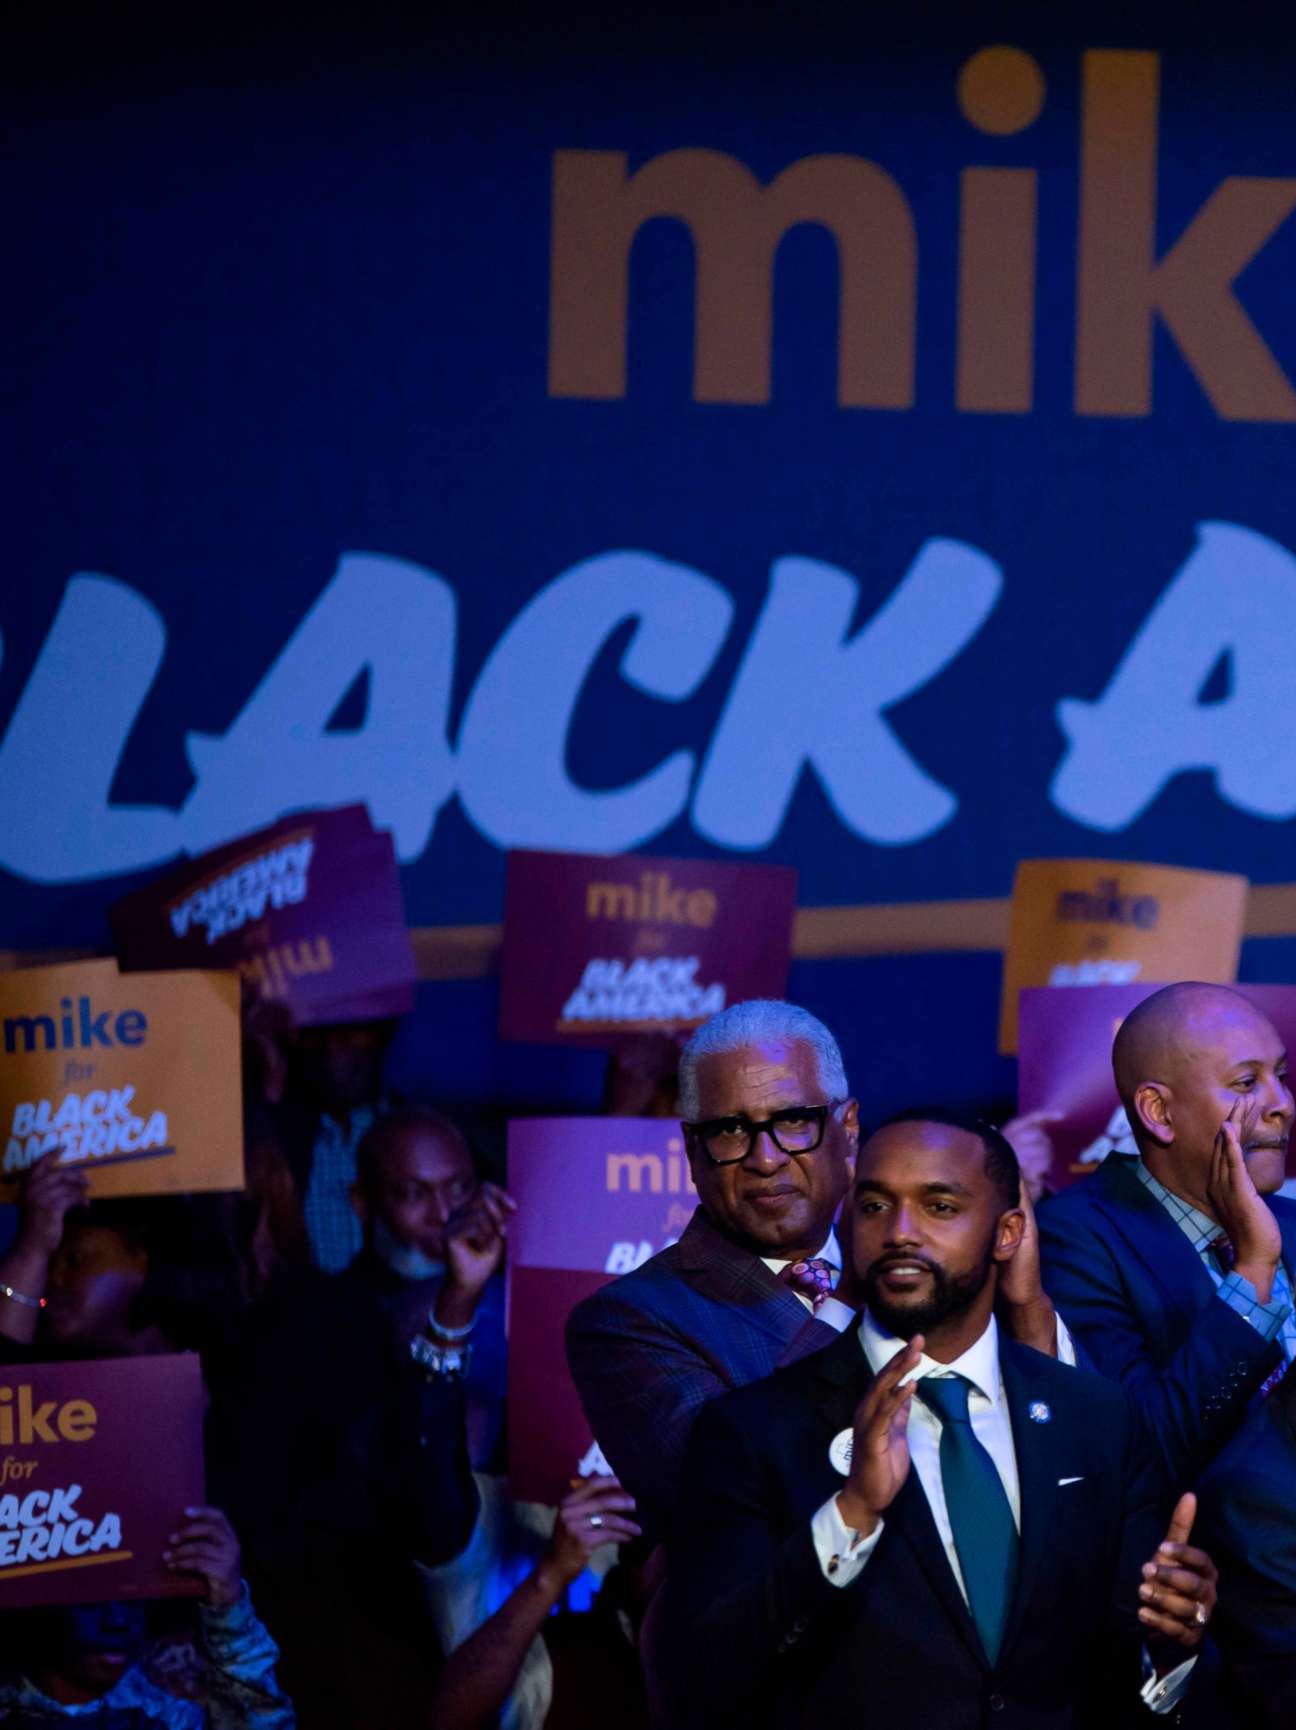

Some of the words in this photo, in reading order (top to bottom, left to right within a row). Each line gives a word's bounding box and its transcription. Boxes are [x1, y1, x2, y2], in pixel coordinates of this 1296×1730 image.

[0, 537, 1003, 884] LACK
[586, 871, 718, 928] mike
[3, 994, 148, 1053] mike
[12, 1083, 136, 1140] BLACK
[0, 1384, 98, 1445] ike
[0, 1455, 39, 1487] for
